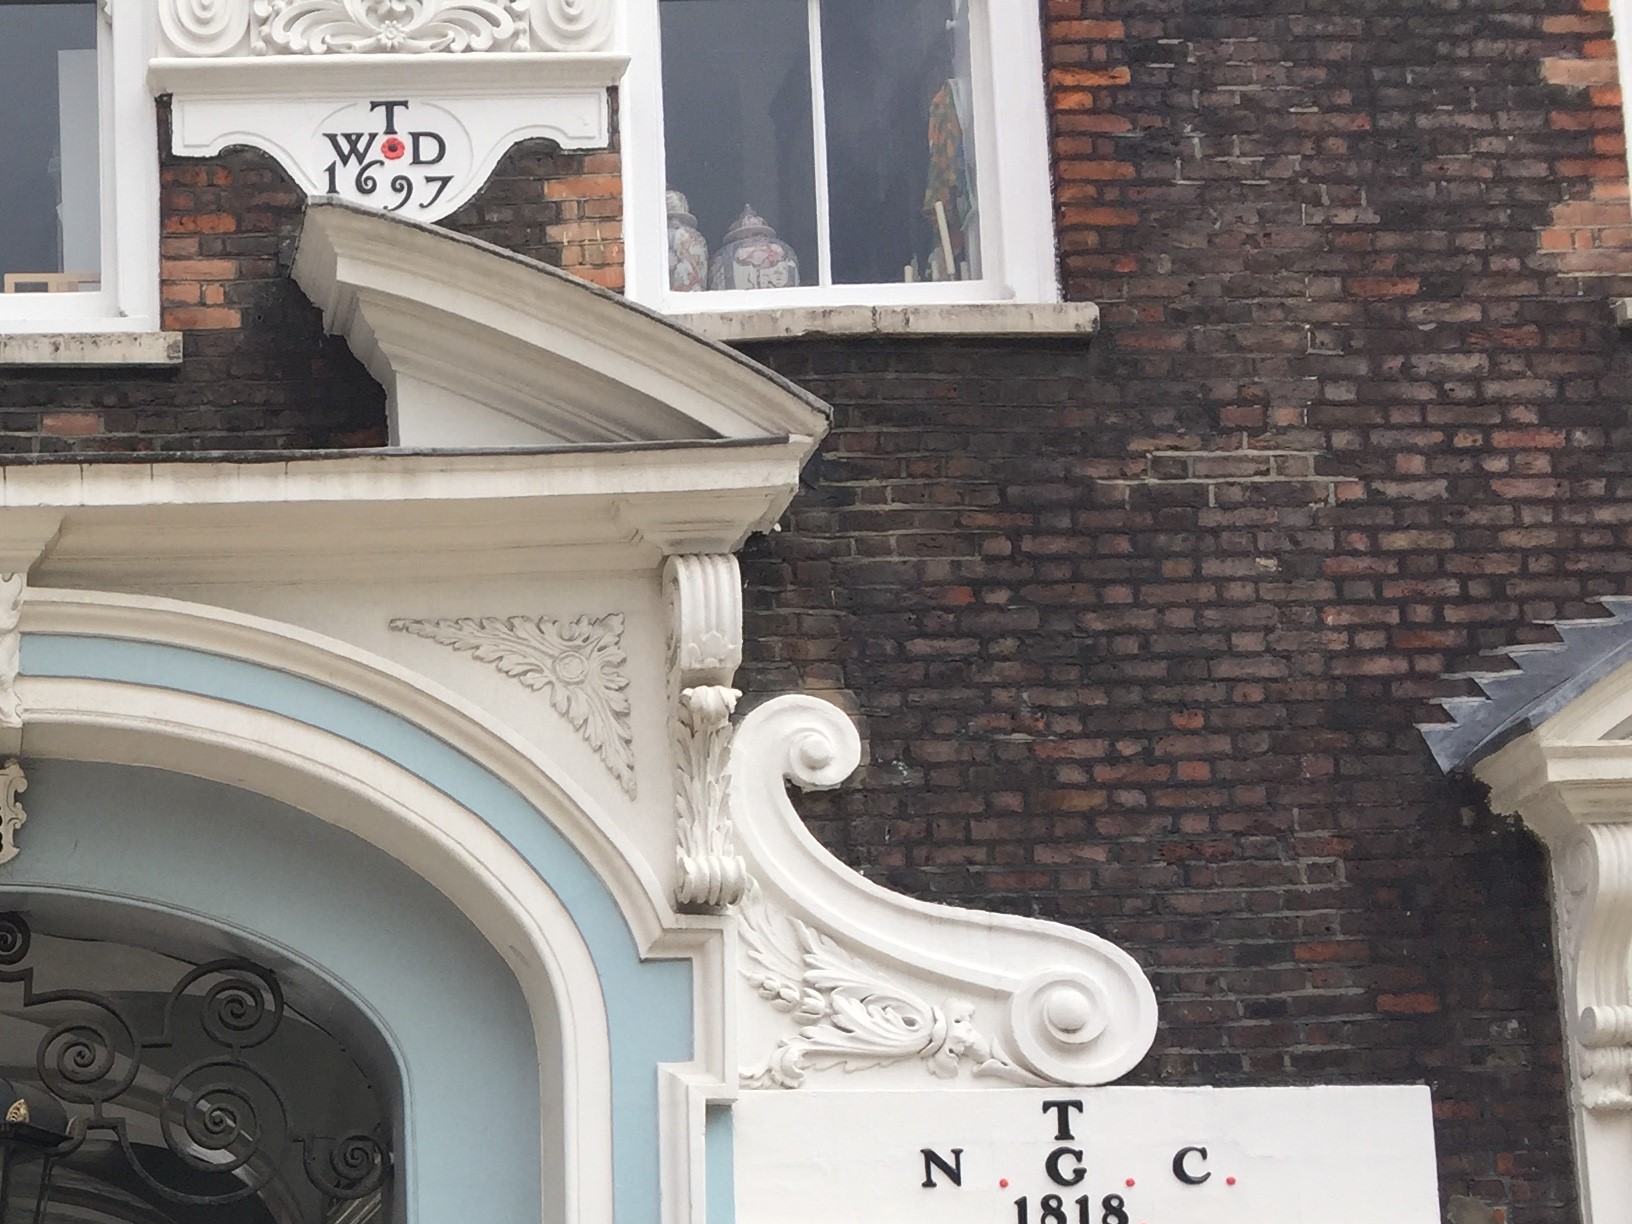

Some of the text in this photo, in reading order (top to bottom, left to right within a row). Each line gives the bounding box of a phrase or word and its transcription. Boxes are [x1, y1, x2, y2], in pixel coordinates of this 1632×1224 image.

[370, 100, 409, 135] T
[322, 131, 446, 167] W D
[323, 160, 455, 212] 1697
[1042, 1099, 1083, 1141] T
